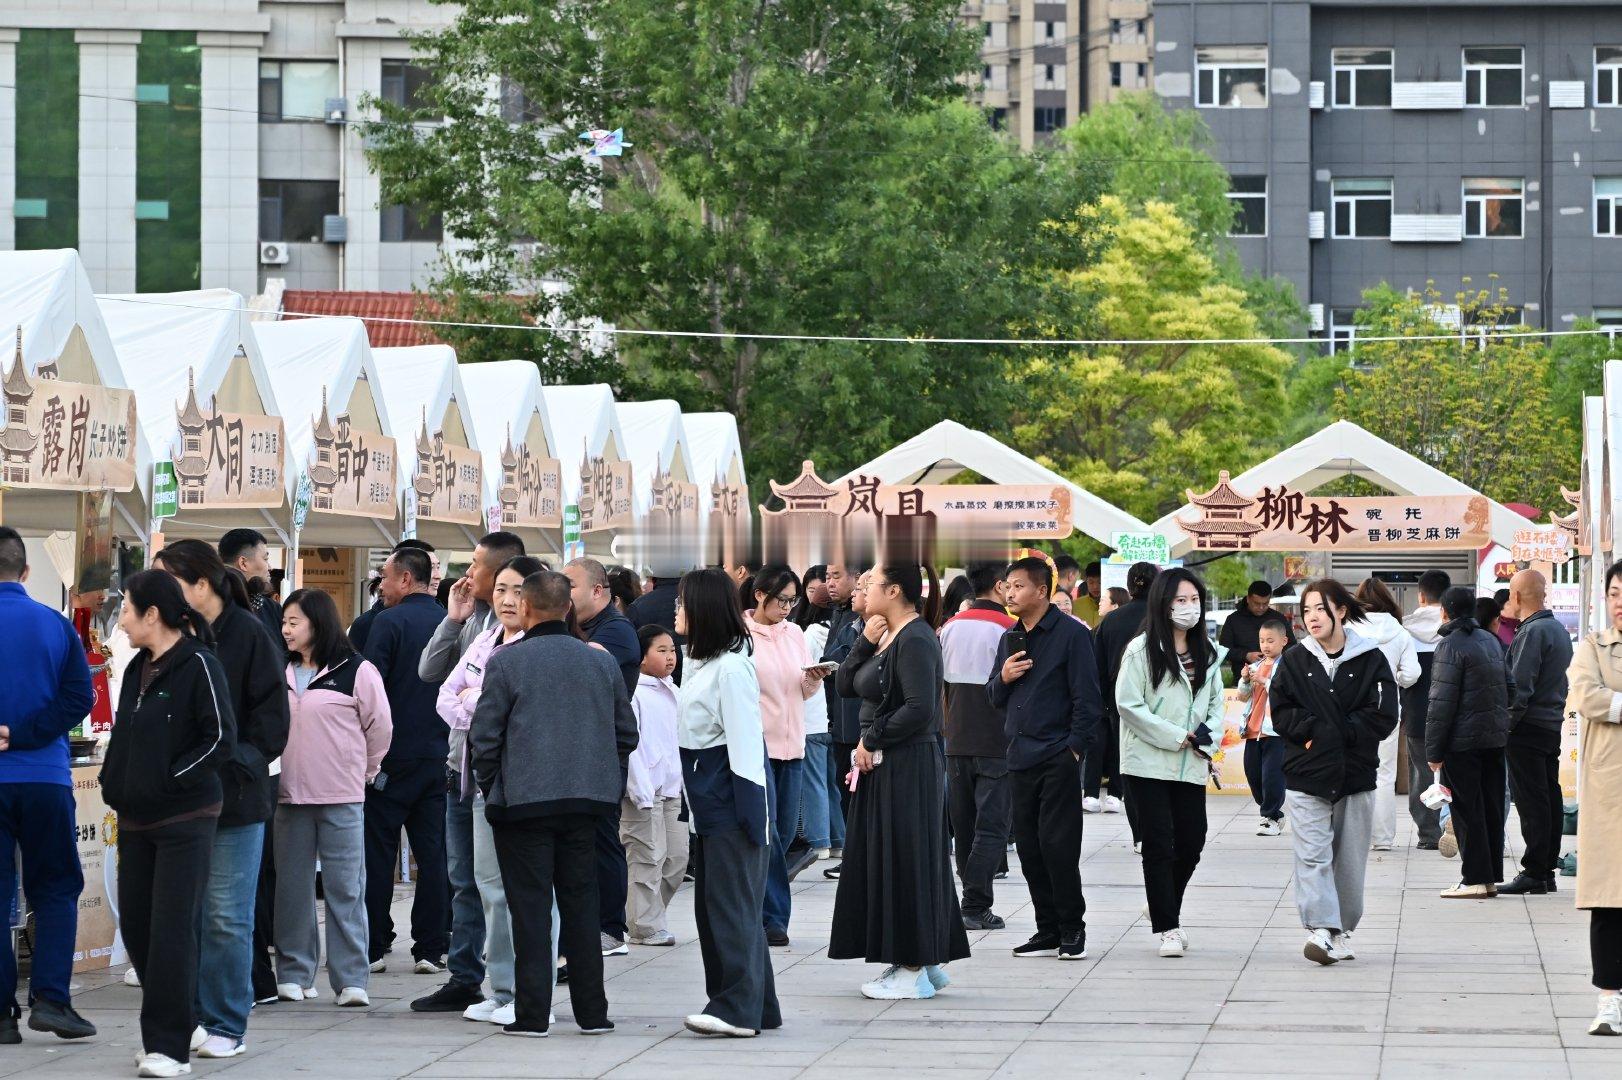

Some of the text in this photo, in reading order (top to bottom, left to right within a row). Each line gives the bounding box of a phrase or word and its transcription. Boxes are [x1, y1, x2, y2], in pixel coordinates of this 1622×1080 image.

[206, 394, 244, 495] 大同
[335, 412, 368, 505] 晋中
[433, 430, 456, 511] 晋中
[944, 500, 987, 510] 水晶蒸饺
[1255, 485, 1359, 544] 柳林
[1366, 507, 1422, 520] 碗托
[1367, 526, 1461, 542] 晋柳芝麻饼
[92, 721, 111, 731] 牛肉
